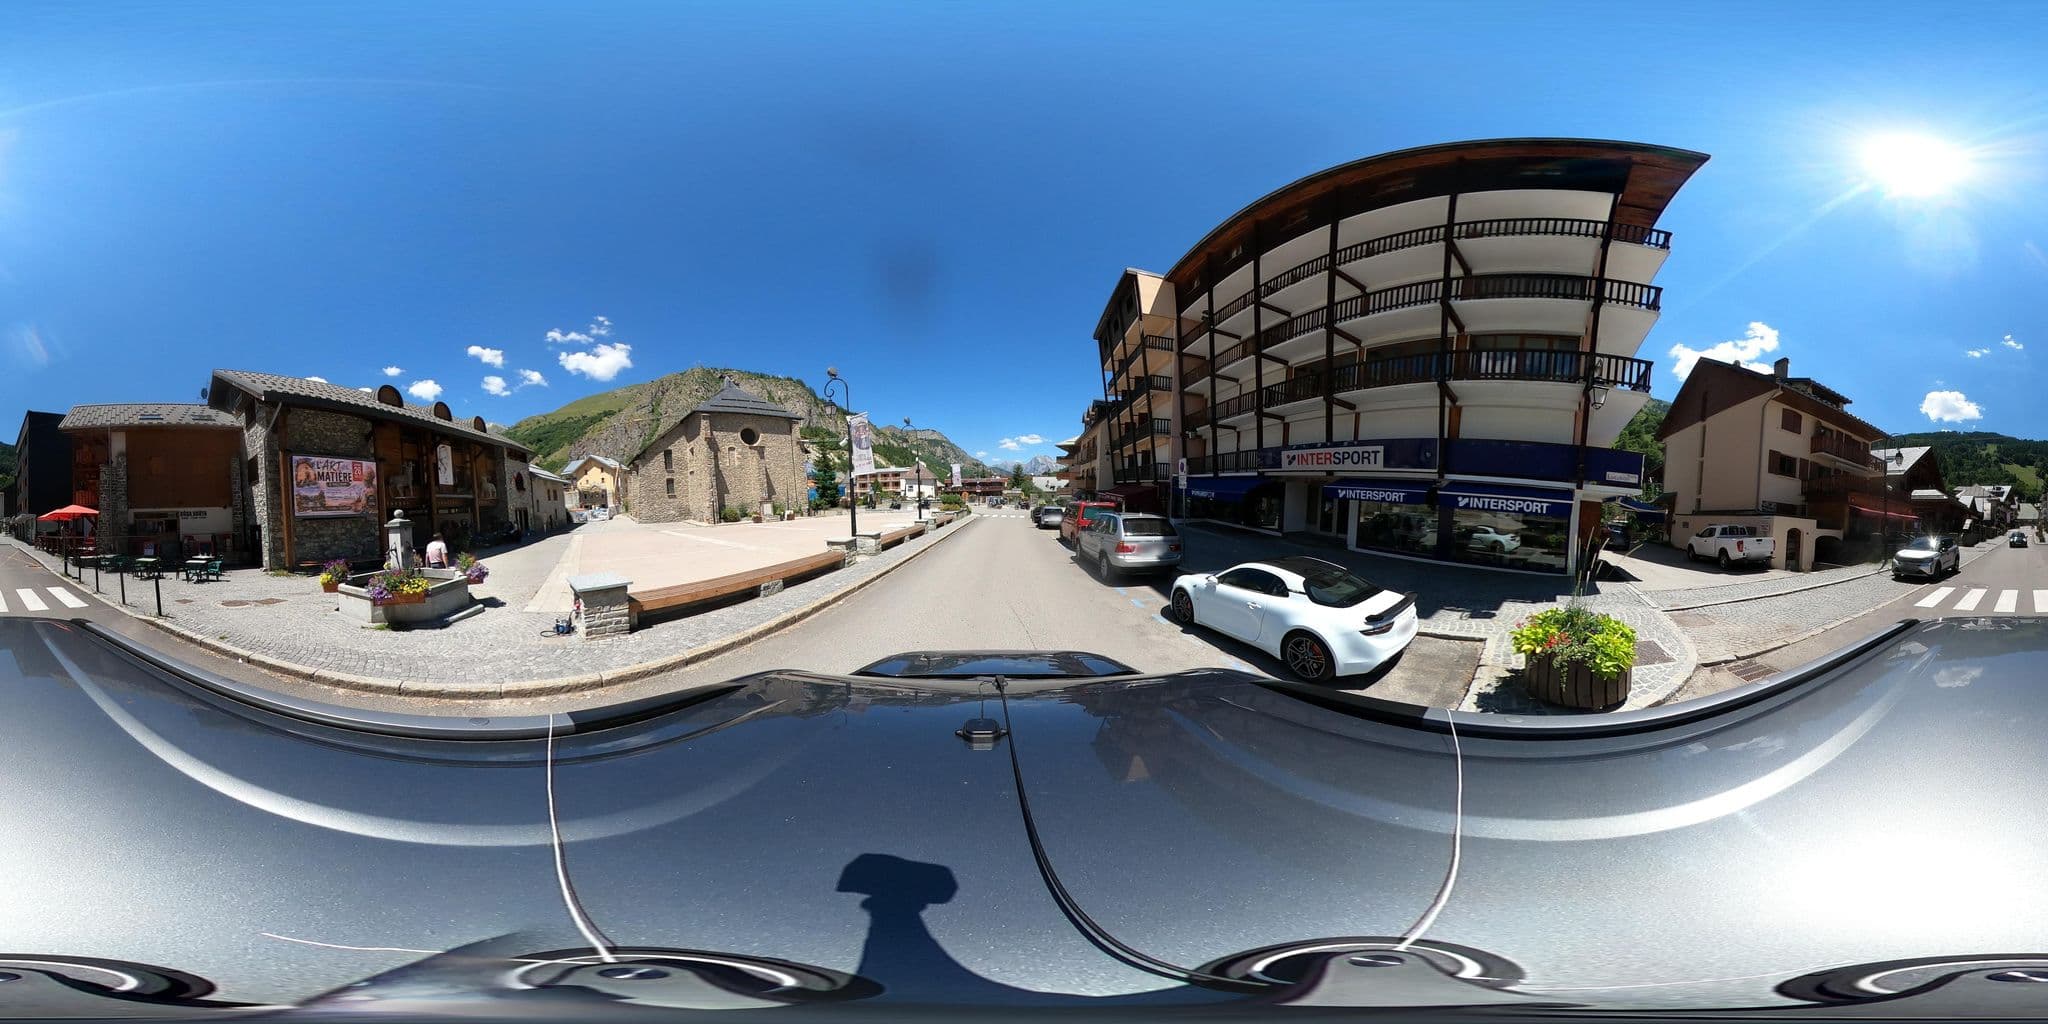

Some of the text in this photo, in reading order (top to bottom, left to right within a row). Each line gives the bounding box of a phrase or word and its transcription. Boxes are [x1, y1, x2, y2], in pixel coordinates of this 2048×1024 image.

[1297, 450, 1380, 465] INTERSPORT
[1346, 489, 1406, 502] INTERSPORT
[1469, 497, 1550, 514] INTERSPORT
